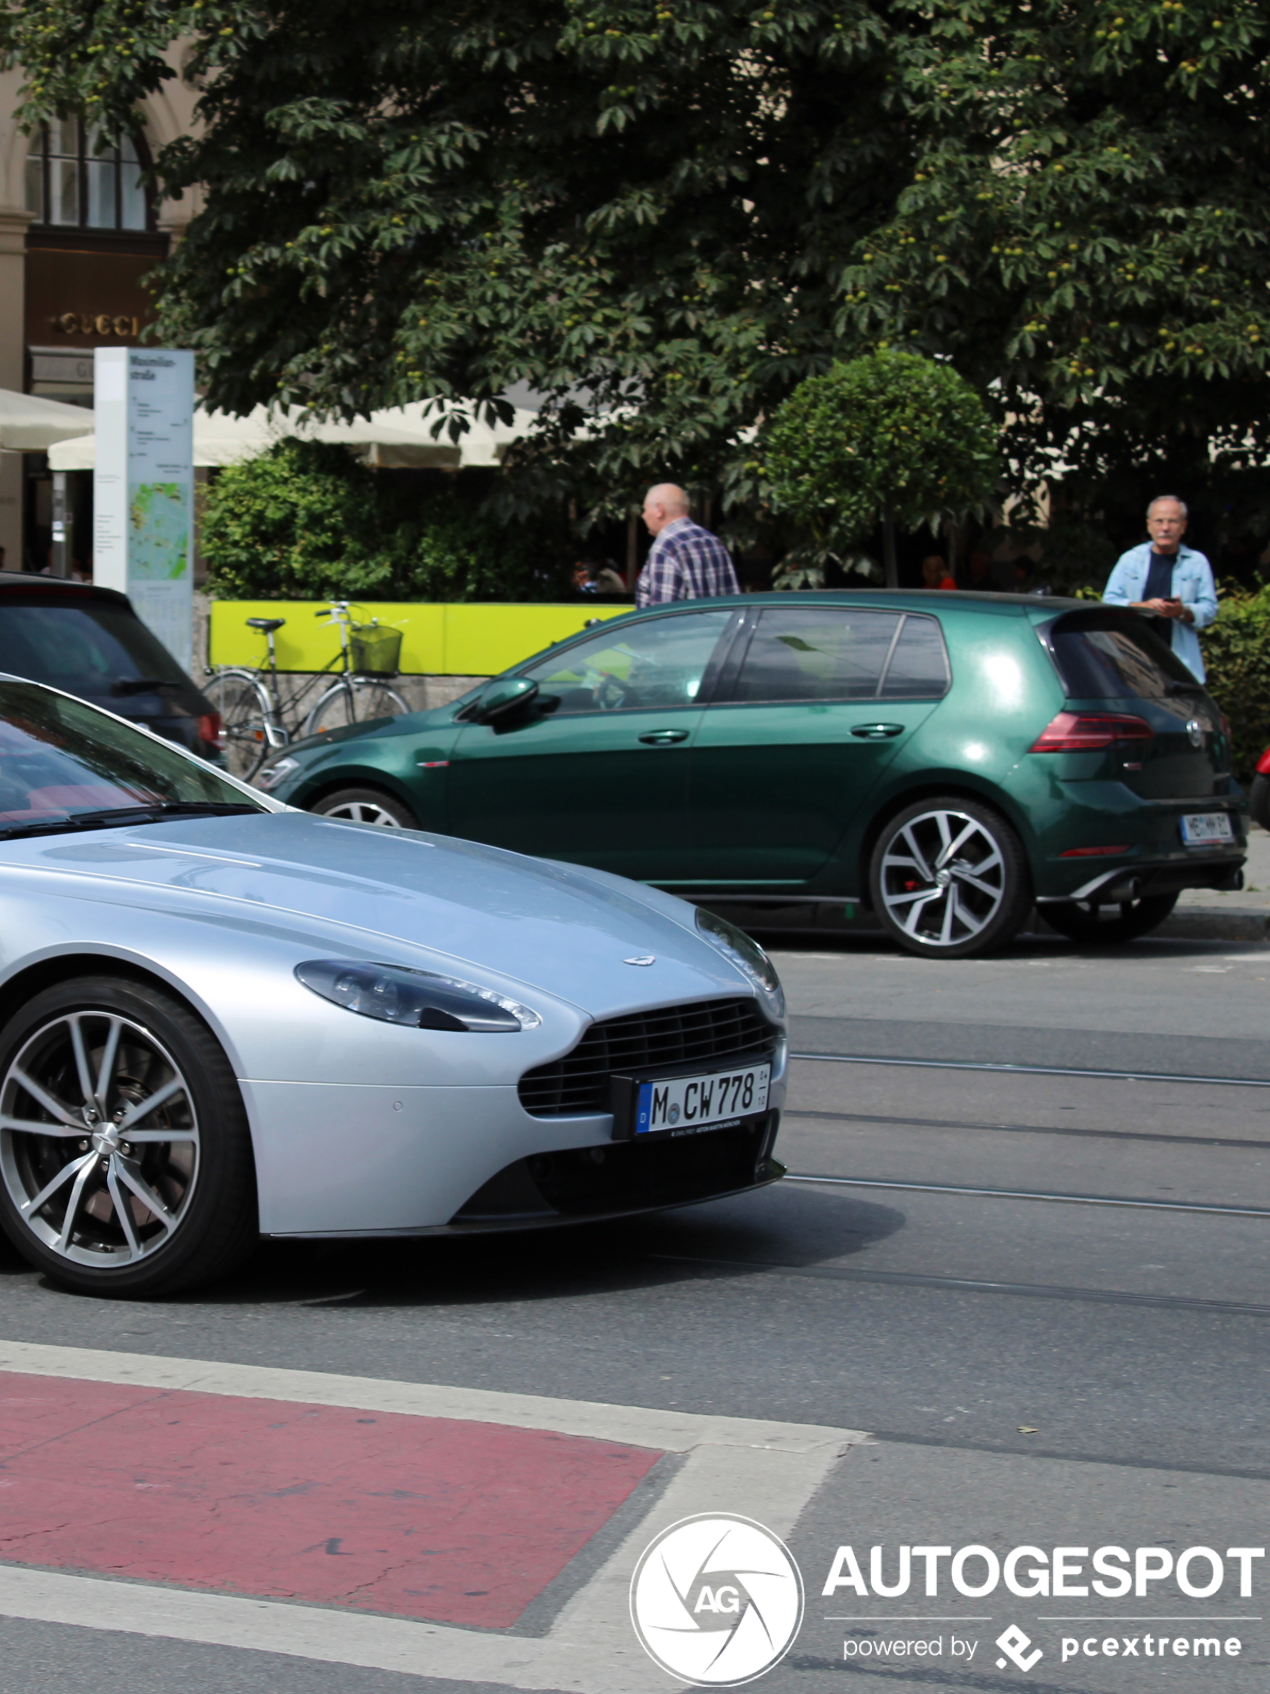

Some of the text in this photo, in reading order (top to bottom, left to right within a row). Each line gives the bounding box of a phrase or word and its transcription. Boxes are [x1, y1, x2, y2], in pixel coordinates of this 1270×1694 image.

[59, 312, 139, 336] GUCCI
[640, 1072, 755, 1125] D M CW 778
